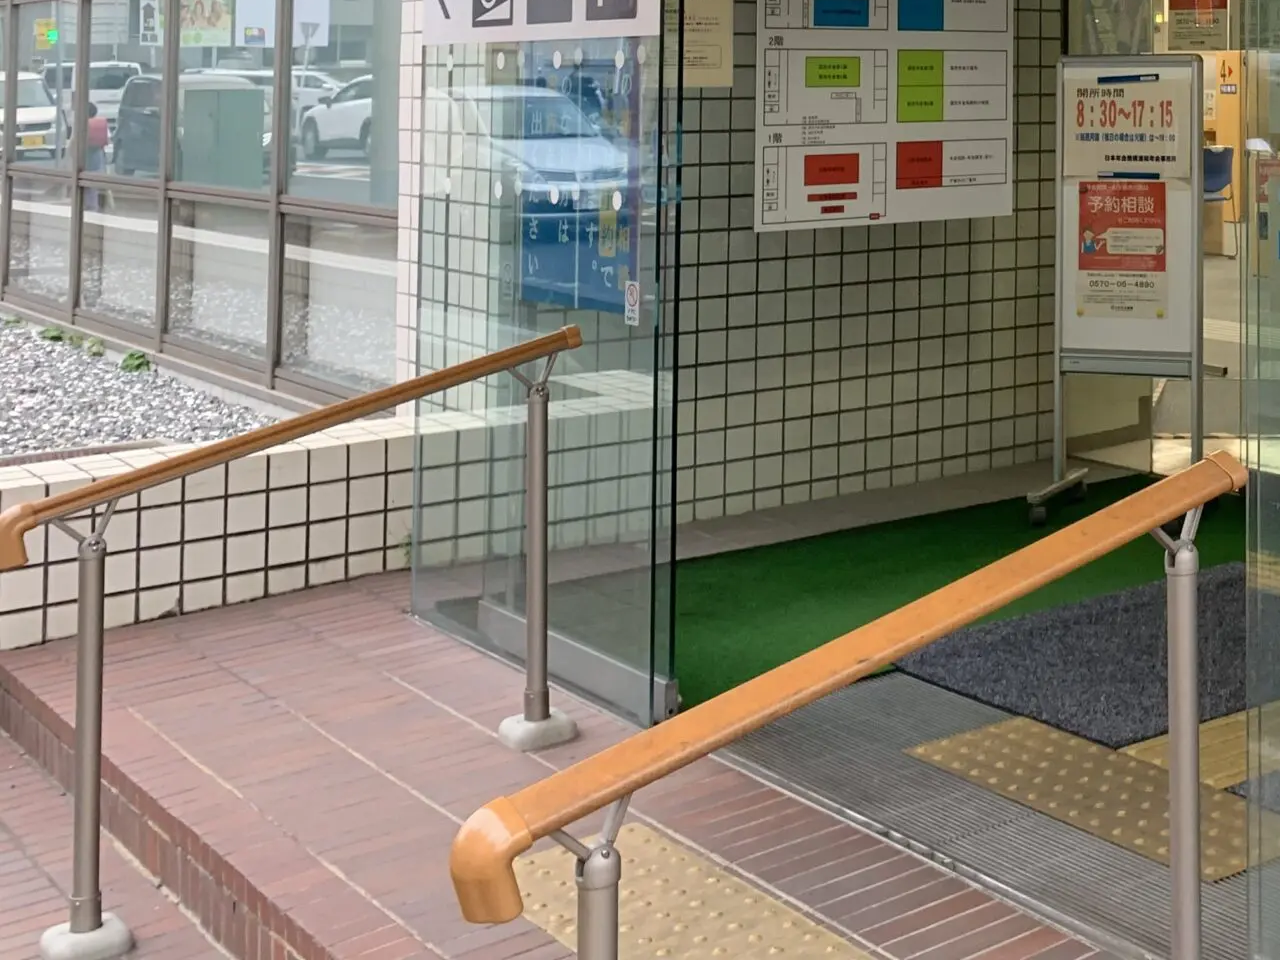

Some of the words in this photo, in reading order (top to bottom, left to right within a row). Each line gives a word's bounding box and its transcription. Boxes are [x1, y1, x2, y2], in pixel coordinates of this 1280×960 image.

[1220, 60, 1227, 82] 4
[1087, 196, 1154, 213] 予約相談
